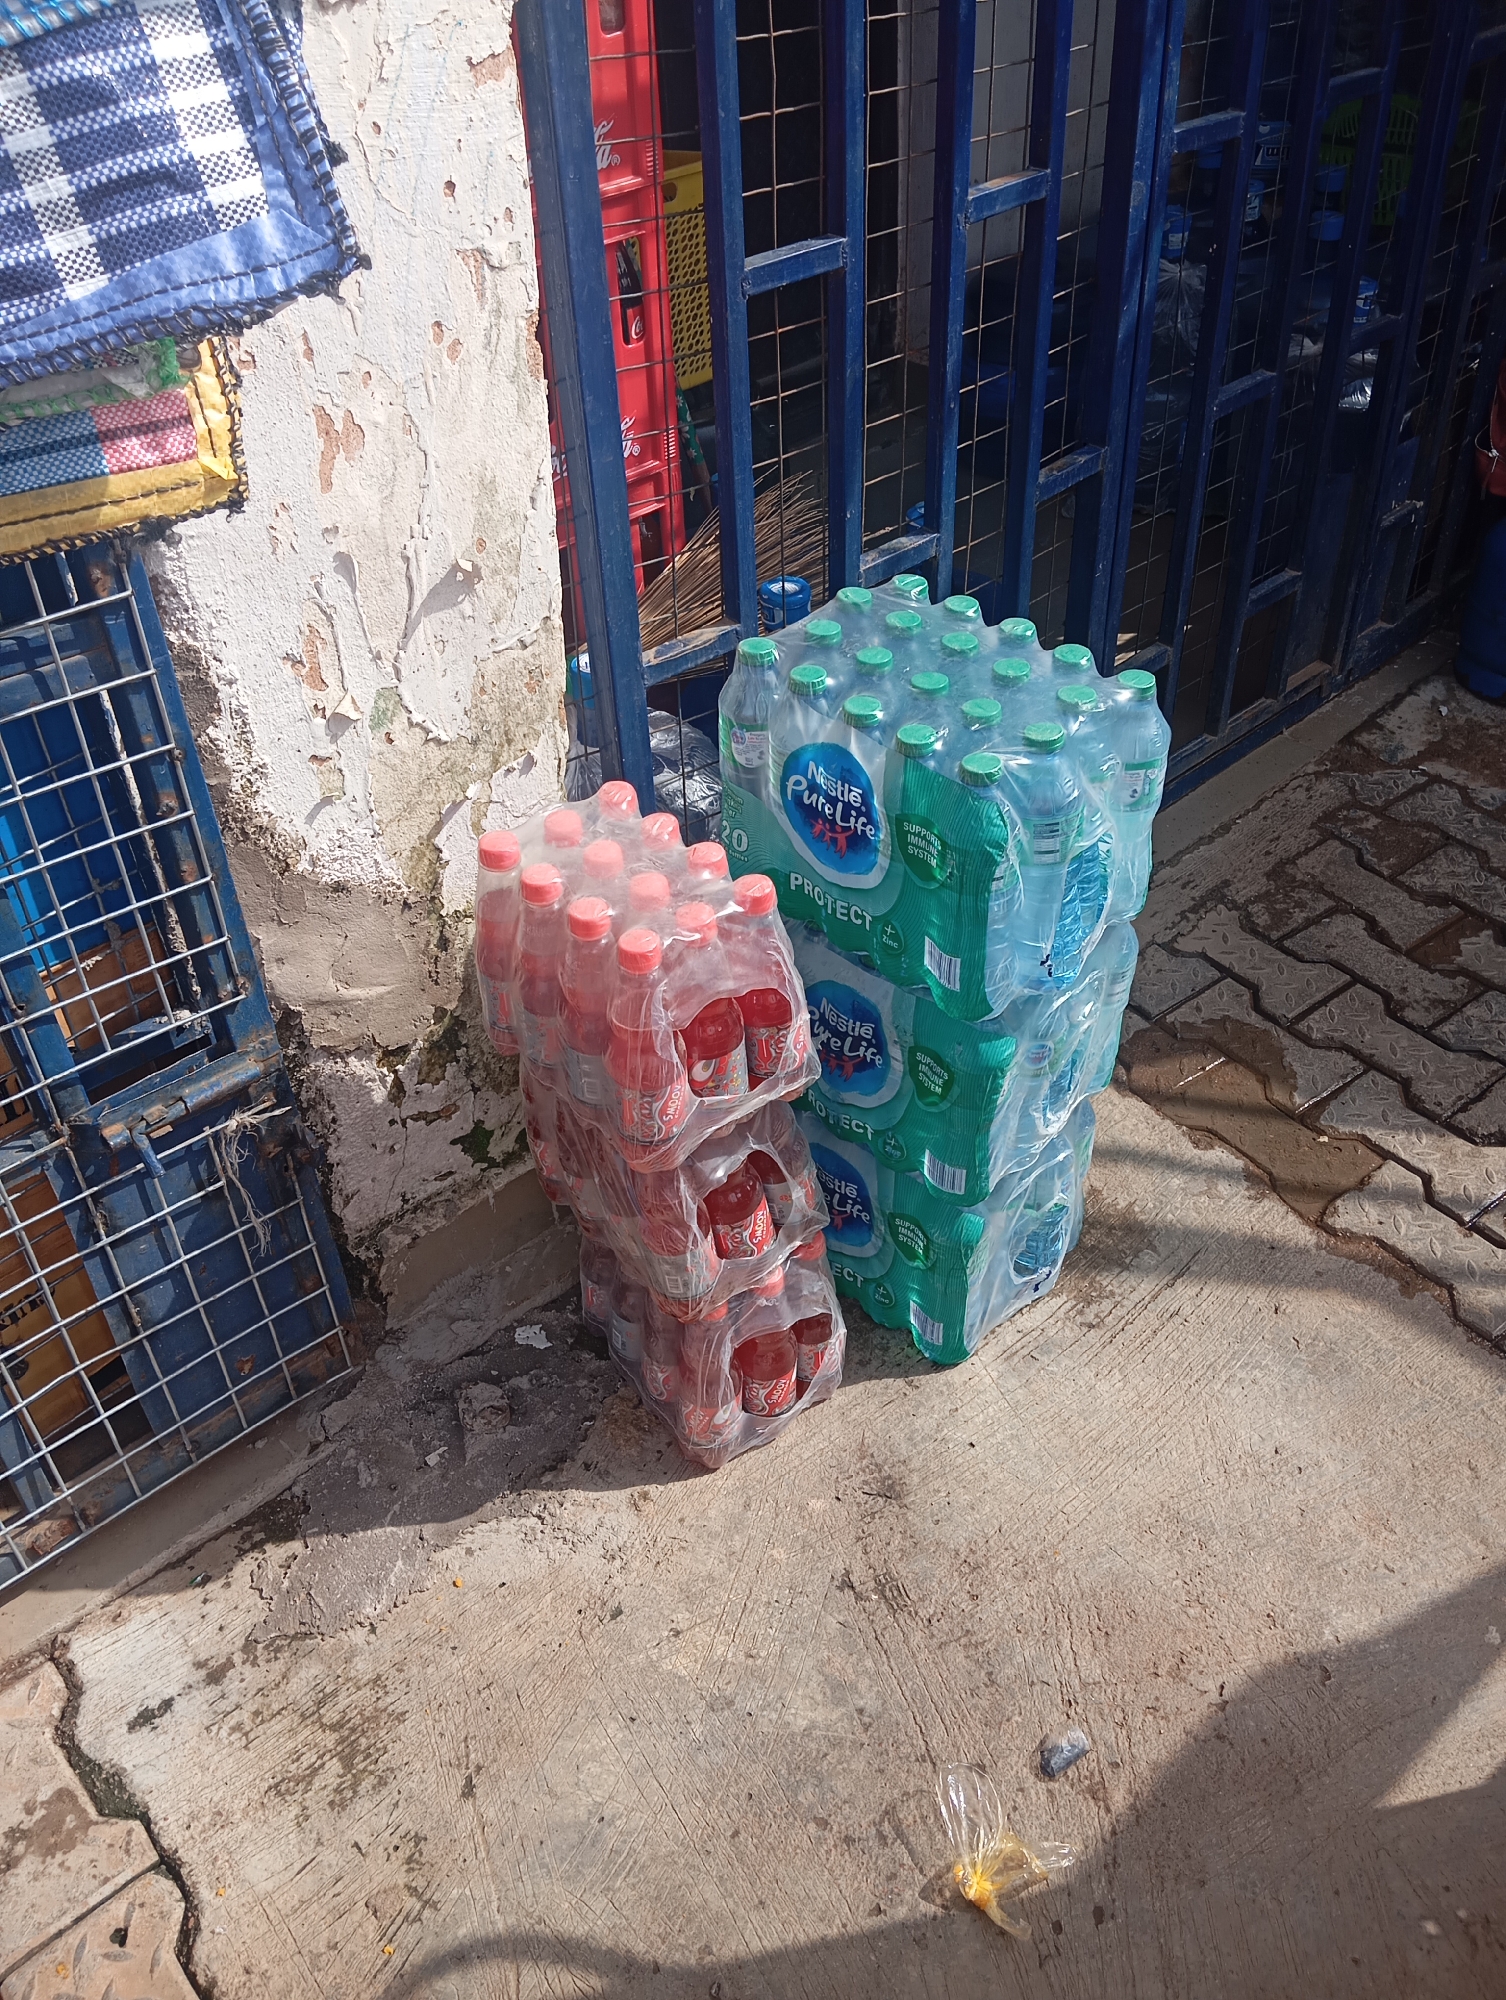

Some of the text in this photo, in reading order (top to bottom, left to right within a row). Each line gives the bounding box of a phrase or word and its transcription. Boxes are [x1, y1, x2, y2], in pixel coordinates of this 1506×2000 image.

[786, 775, 834, 819] Pure
[835, 802, 876, 839] Life
[722, 820, 749, 852] 20
[904, 822, 941, 850] SUPPORTS
[907, 834, 938, 857] IMMUNE
[908, 845, 936, 868] SYSTEM
[790, 872, 872, 931] PROTECT
[882, 935, 898, 948] Zinc
[843, 1037, 883, 1068] Life
[916, 1052, 949, 1080] SUPPORTS
[918, 1063, 943, 1086] IMMUNE
[918, 1072, 942, 1095] SYSTEM
[802, 1089, 875, 1141] ROTECT
[817, 1163, 858, 1198] estlé
[833, 1193, 870, 1224] Life
[753, 1210, 764, 1243] SMOOV
[895, 1218, 927, 1246] SUPPORTS
[898, 1226, 923, 1249] IMMUNE
[898, 1234, 923, 1255] SYSTEM
